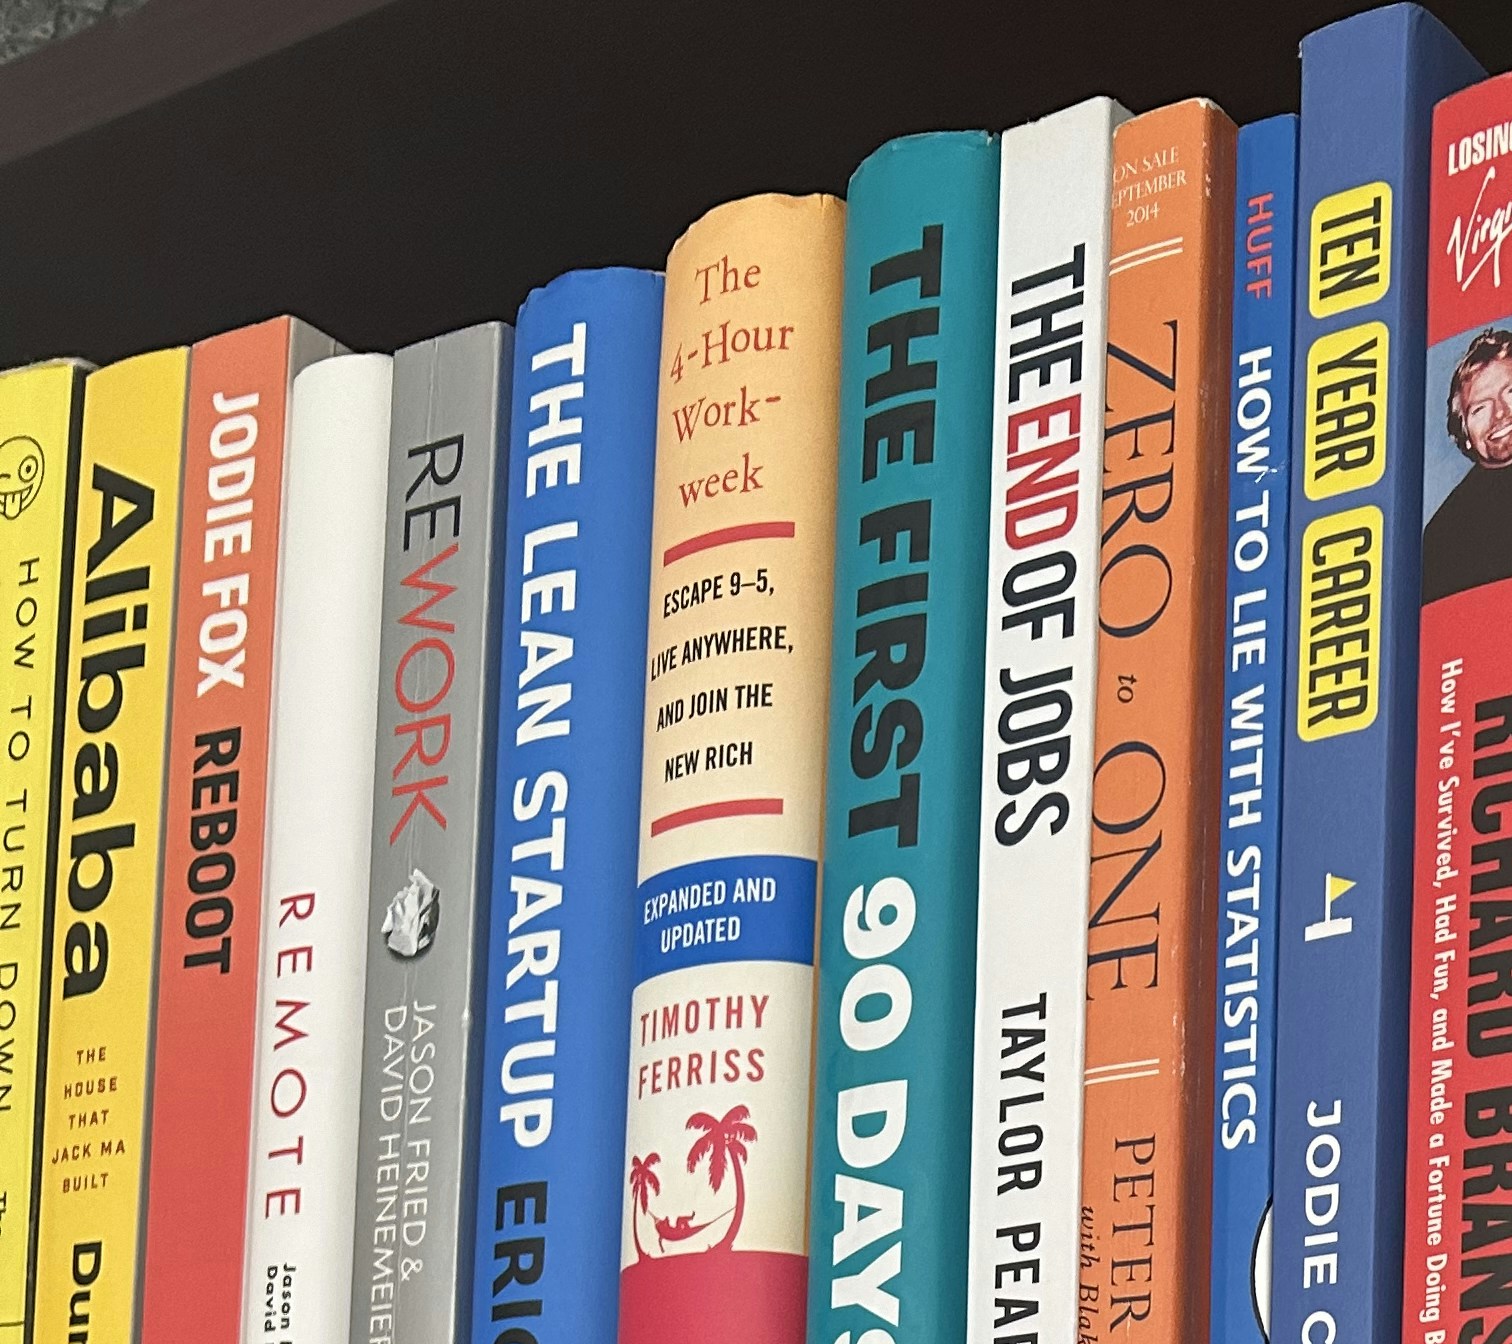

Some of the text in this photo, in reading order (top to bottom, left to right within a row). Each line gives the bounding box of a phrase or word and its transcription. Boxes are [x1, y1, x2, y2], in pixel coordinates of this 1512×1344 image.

[694, 254, 762, 306] The
[1246, 192, 1274, 300] HUFF
[525, 322, 587, 499] THE
[861, 224, 944, 485] THE
[678, 452, 764, 508] week
[994, 242, 1086, 848] THE END OF JOBS
[1306, 195, 1382, 729] TEN YEAR CAREER
[63, 463, 156, 1000] Alibaba
[515, 521, 579, 747] LEAN
[656, 683, 774, 732] AND JOIN THE
[848, 499, 932, 849] FIRST
[1086, 318, 1179, 1002] ZERO to ONE
[1221, 345, 1273, 1151] HOW TO LIE WITH STATISTICS
[76, 1046, 107, 1063] THE
[500, 769, 570, 1149] STARTUP
[839, 876, 917, 1052] 90
[62, 1173, 109, 1194] BUILT
[63, 1076, 118, 1100] HOUSE
[400, 1001, 436, 1283] JASON FRIED &
[996, 991, 1047, 1196] TAYLOR
[1302, 1099, 1342, 1290] JODIE
[279, 1262, 297, 1331] Jason
